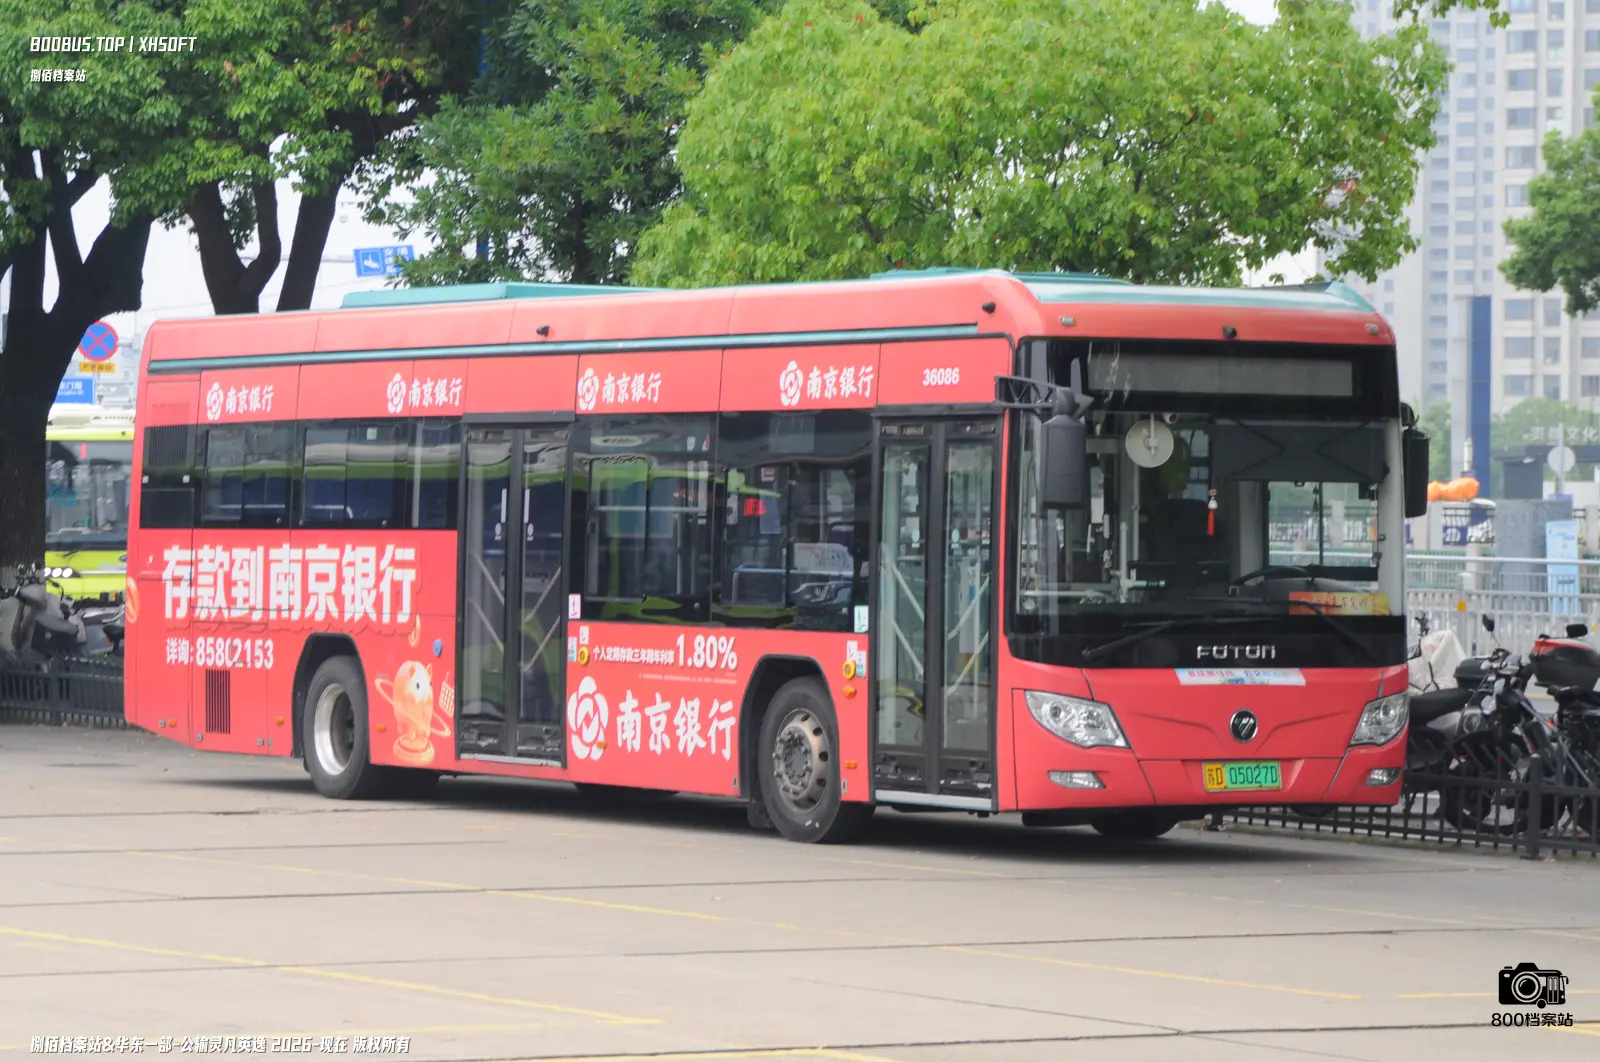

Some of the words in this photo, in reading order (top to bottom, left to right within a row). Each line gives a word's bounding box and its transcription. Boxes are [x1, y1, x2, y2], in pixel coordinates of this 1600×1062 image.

[408, 377, 462, 409] 南京银行
[602, 372, 662, 404] 南京银行
[806, 365, 875, 400] 南京银行
[922, 367, 961, 387] 36086
[225, 384, 275, 415] 南京银行
[162, 544, 416, 624] 存款到南京银行
[676, 634, 738, 671] 1.80%
[1196, 645, 1276, 659] FOTON
[616, 690, 736, 762] 南京银行
